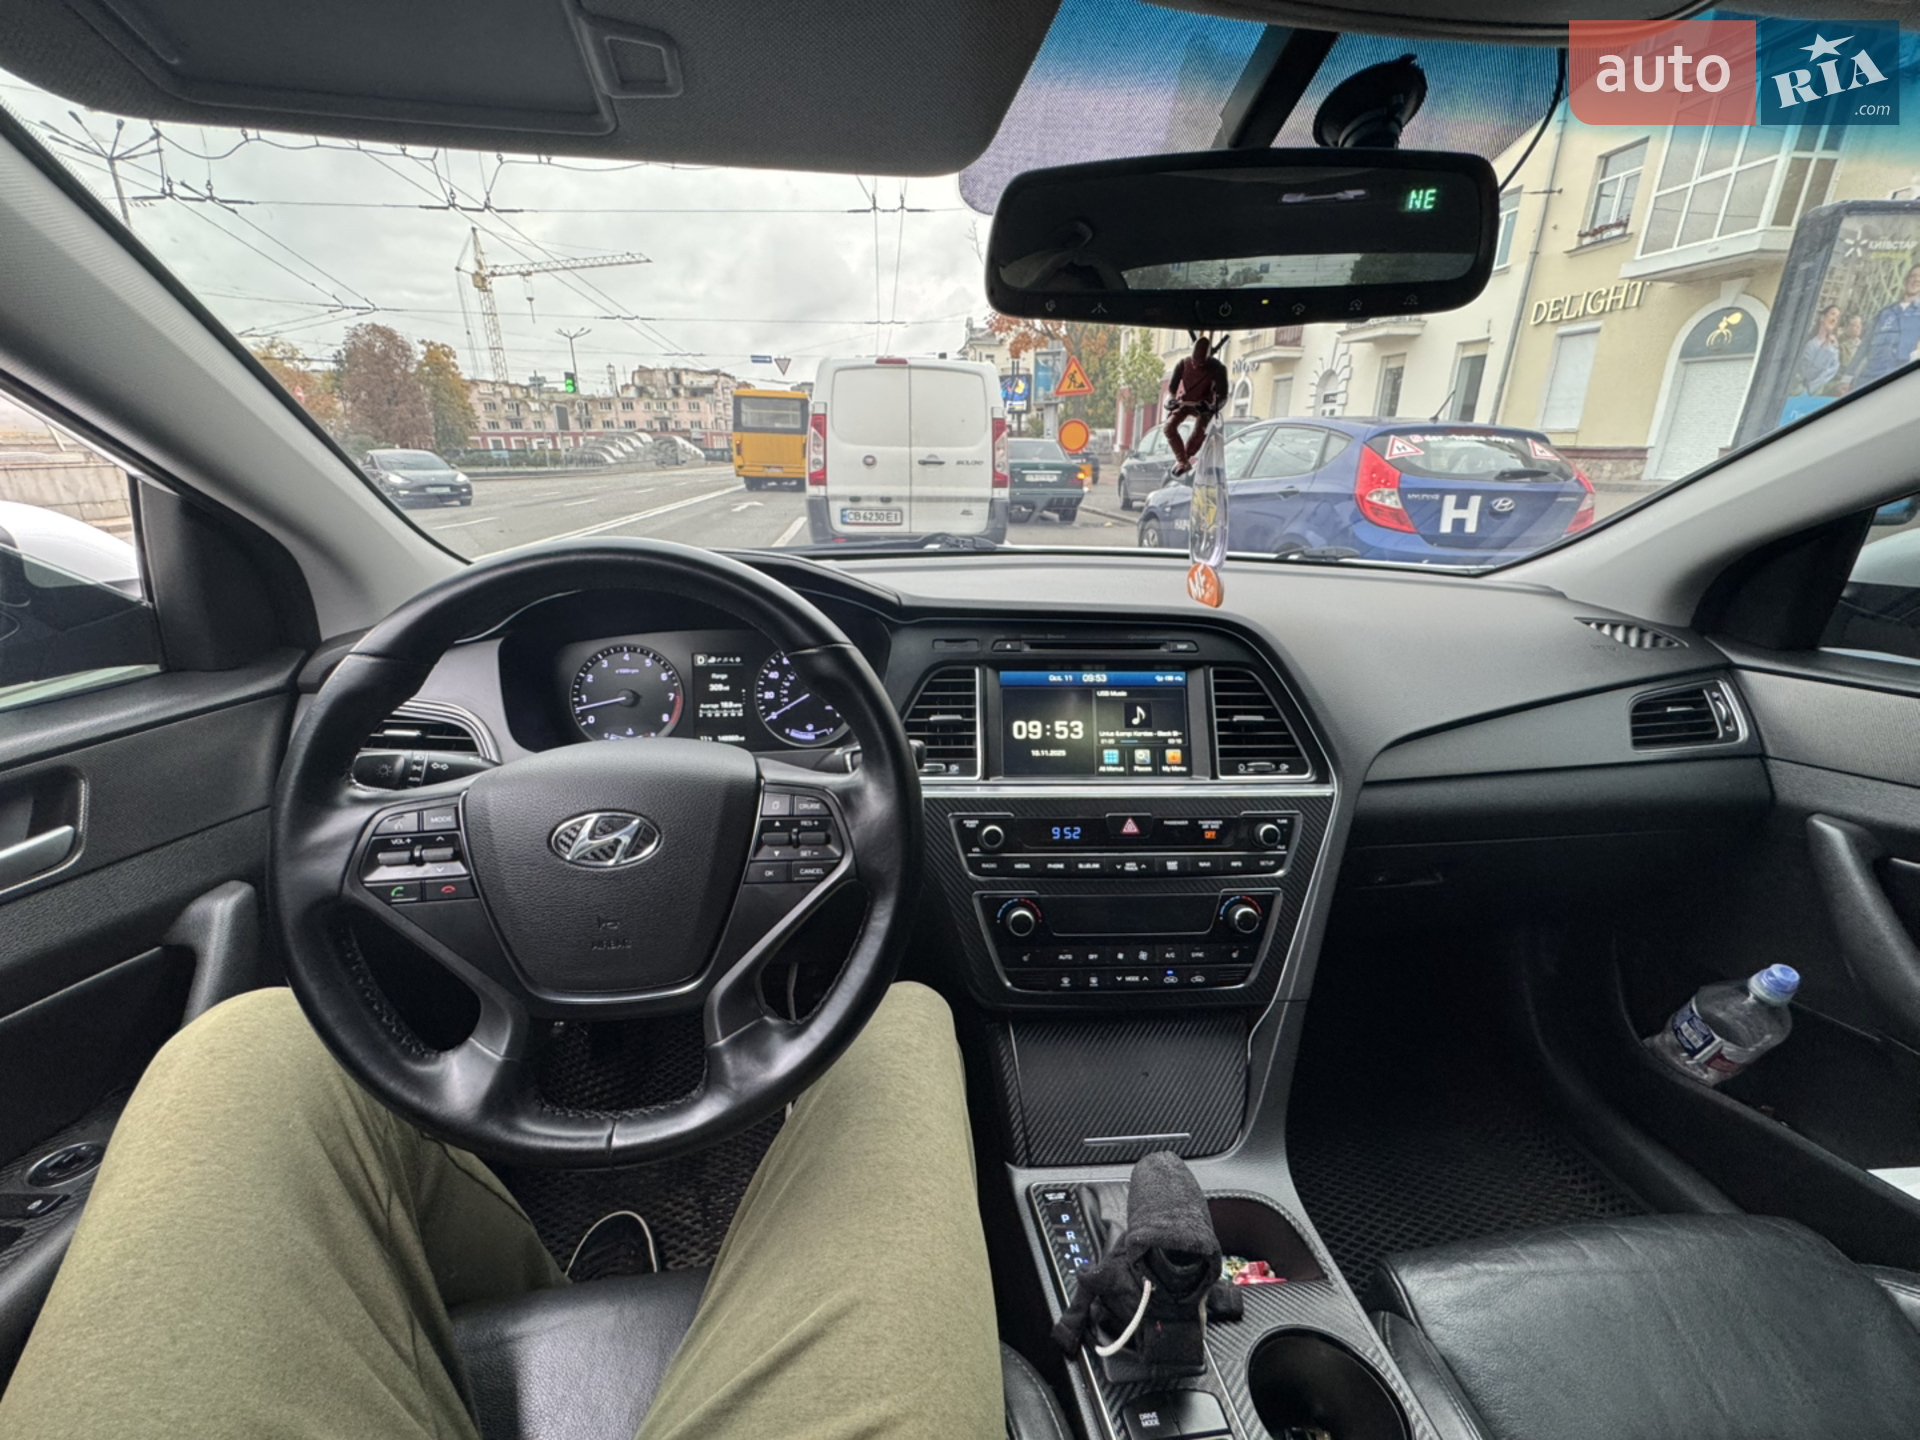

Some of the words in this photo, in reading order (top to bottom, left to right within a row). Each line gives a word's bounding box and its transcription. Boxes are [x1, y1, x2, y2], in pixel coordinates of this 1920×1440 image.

[1408, 188, 1437, 210] NE
[1529, 280, 1652, 327] DELIGHT
[847, 510, 861, 521] CB
[863, 511, 884, 522] 6230
[886, 511, 898, 522] EI
[623, 653, 630, 661] 4
[601, 659, 608, 668] 3
[645, 658, 652, 667] 5
[586, 674, 594, 682] 2
[660, 672, 668, 681] 6
[768, 671, 780, 680] 40
[668, 692, 675, 701] 7
[763, 691, 775, 699] 20
[430, 815, 453, 823] MODE
[799, 867, 824, 875] CANCEL
[1061, 1214, 1070, 1223] P
[1066, 1230, 1076, 1240] R
[1069, 1243, 1080, 1254] N
[1138, 1411, 1158, 1420] DRIVE
[1140, 1419, 1160, 1428] MODE
